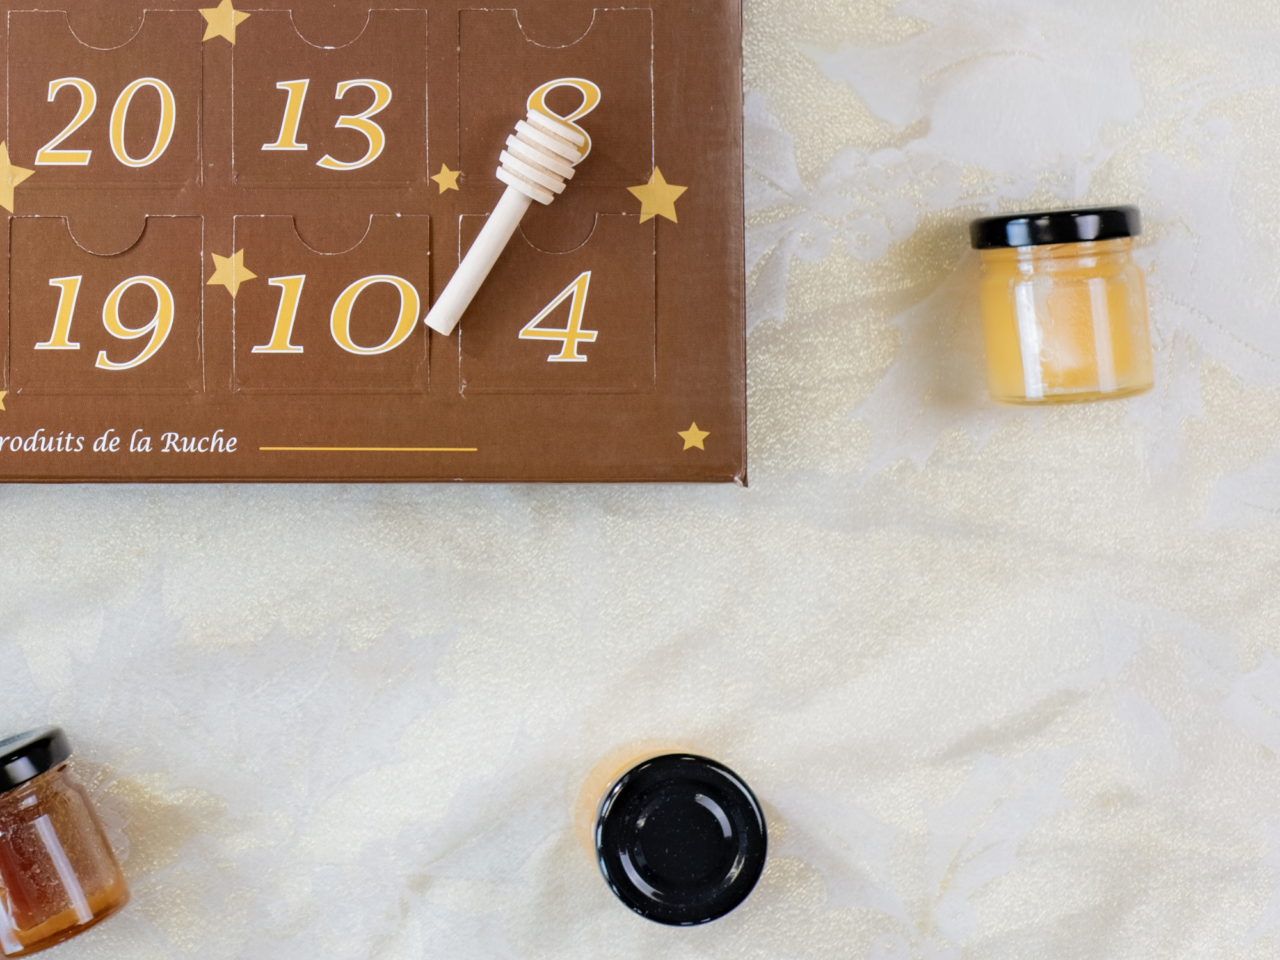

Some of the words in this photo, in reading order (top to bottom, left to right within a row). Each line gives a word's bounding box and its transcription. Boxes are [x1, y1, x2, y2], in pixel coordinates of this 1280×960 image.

[34, 76, 176, 168] 20
[261, 78, 392, 171] 13
[34, 274, 174, 371] 19
[251, 273, 420, 356] 10
[518, 270, 598, 362] 4
[92, 428, 120, 453] de
[129, 428, 152, 453] la
[160, 428, 237, 453] Ruche
